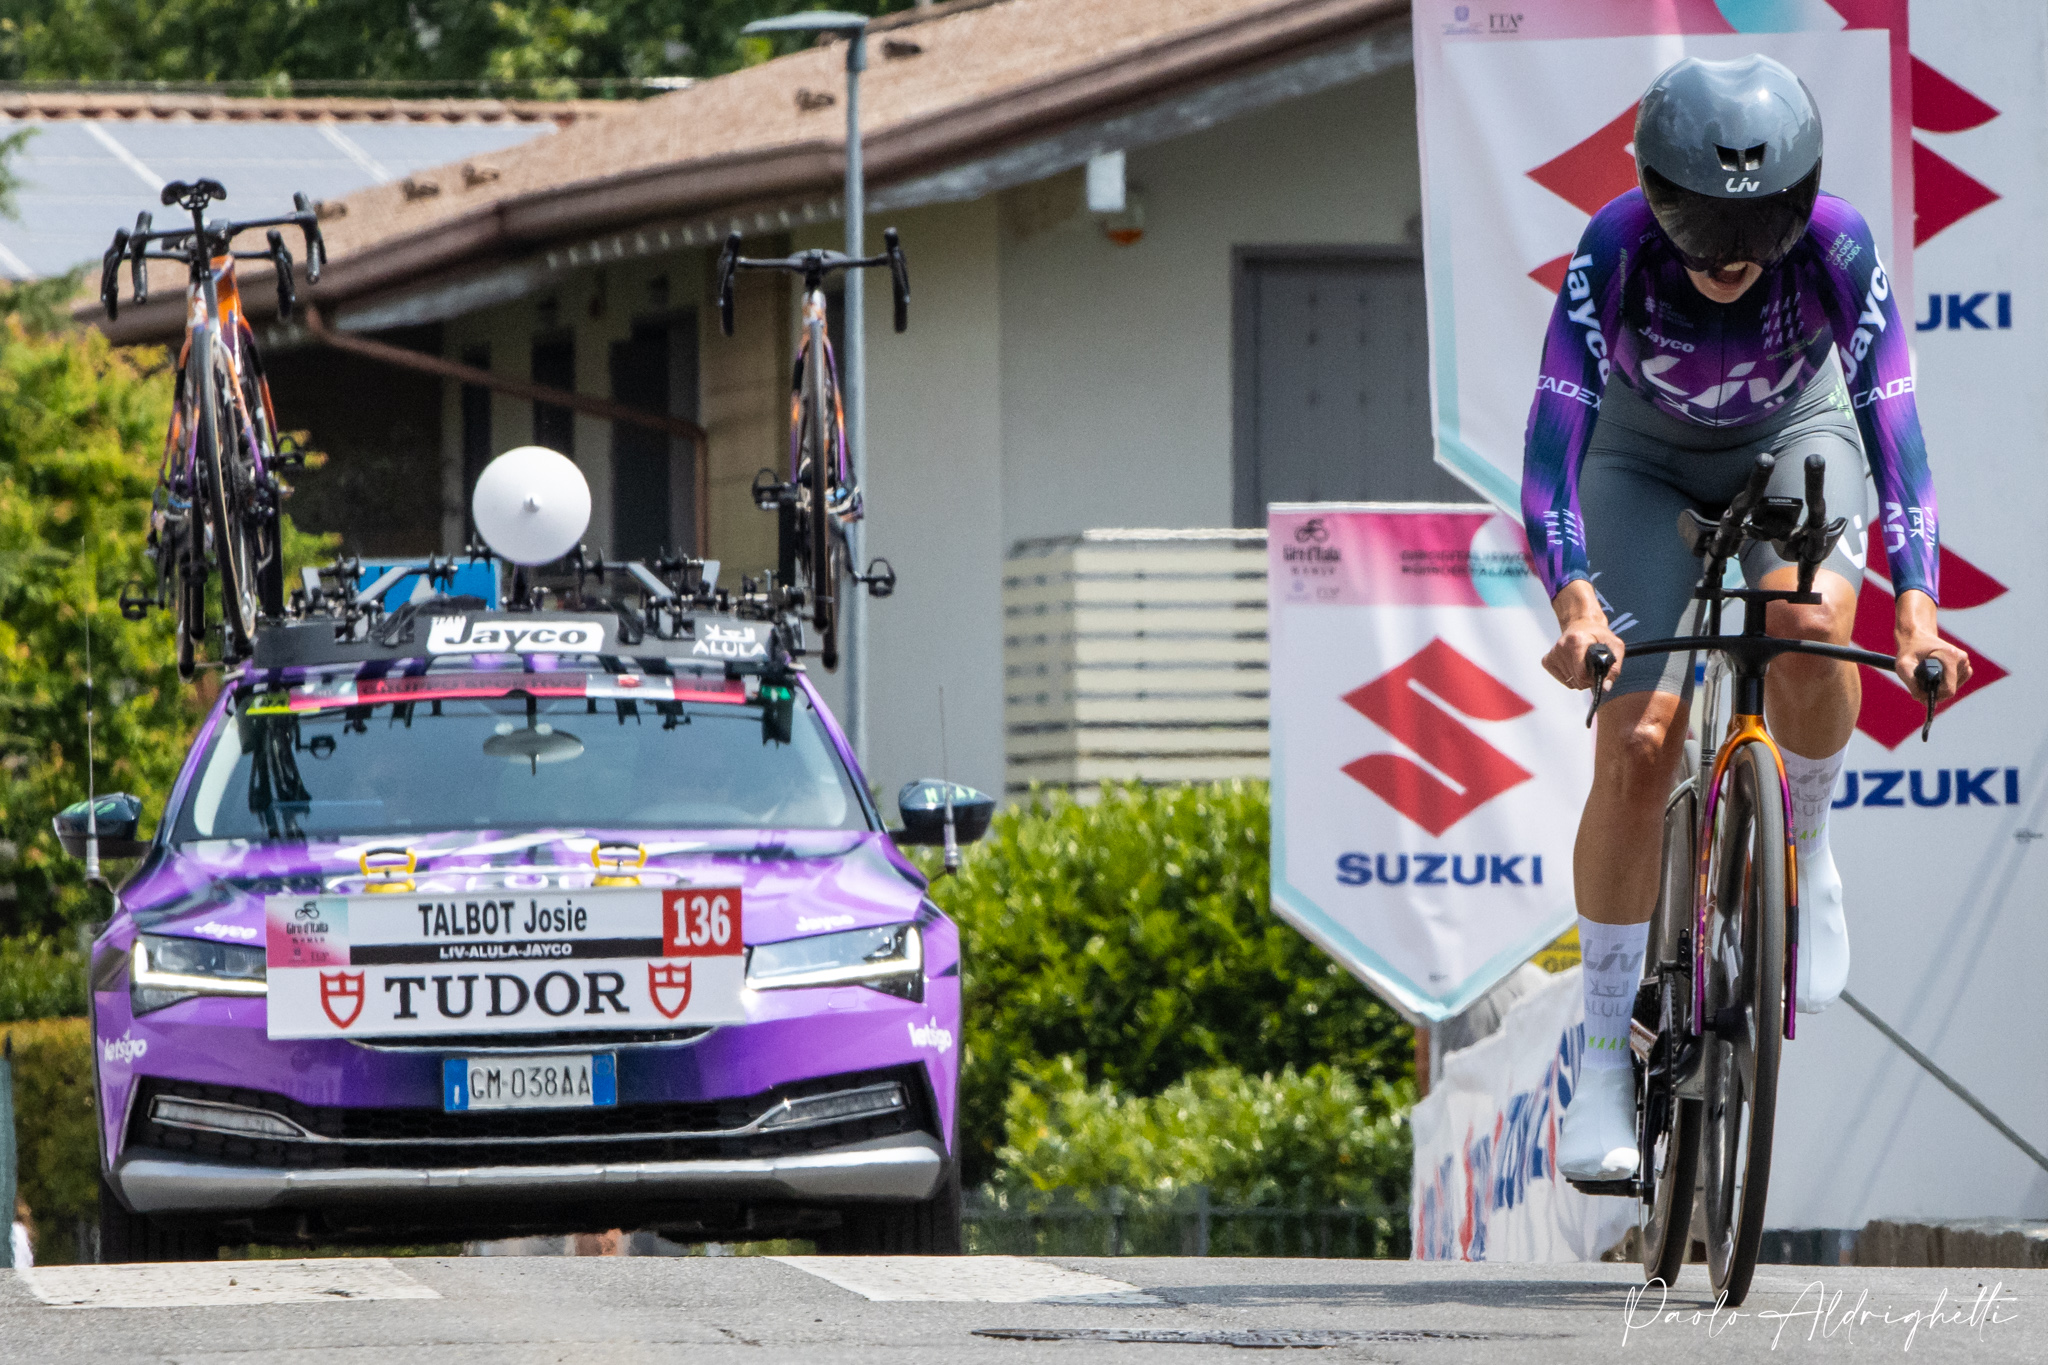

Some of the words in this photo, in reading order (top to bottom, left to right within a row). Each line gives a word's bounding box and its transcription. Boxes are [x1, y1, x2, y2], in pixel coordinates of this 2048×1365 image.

[1725, 177, 1760, 193] Liv
[1567, 253, 1611, 386] Jayco
[1841, 243, 1888, 385] Jayc
[1915, 291, 2012, 332] UKI
[1638, 326, 1695, 353] Jayco
[1853, 376, 1916, 409] CADE
[1543, 510, 1563, 545] MAAP
[443, 616, 588, 653] Jayco
[693, 639, 769, 658] ALULA
[1831, 766, 2019, 810] UZUKI
[1336, 852, 1544, 886] SUZUKI
[418, 901, 515, 937] TALBOT
[524, 899, 588, 935] Josie
[673, 895, 732, 948] 136
[384, 970, 630, 1020] TUDOR
